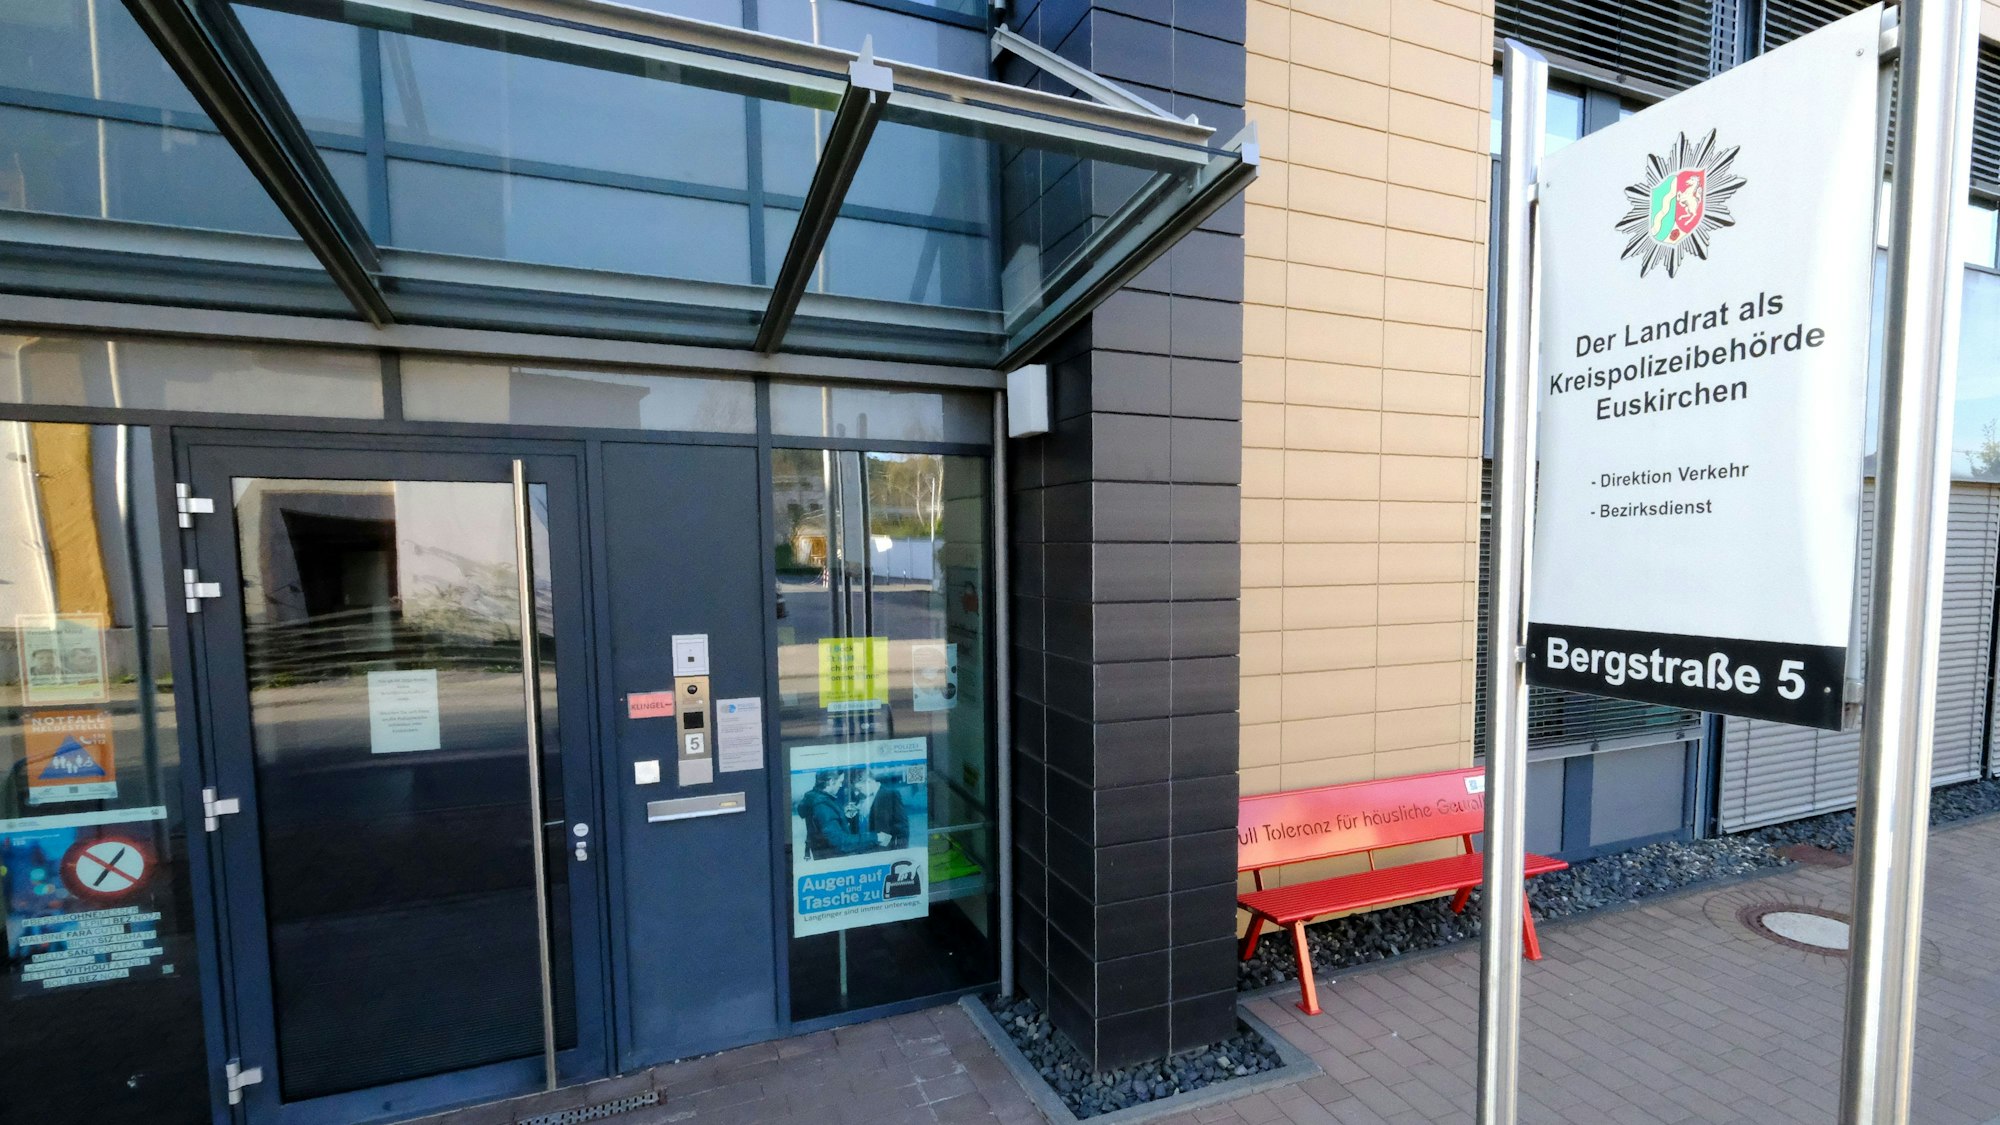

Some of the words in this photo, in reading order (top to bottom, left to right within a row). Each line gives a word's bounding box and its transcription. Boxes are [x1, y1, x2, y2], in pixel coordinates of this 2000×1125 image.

[1576, 333, 1616, 357] Der
[1624, 302, 1729, 347] Landrat
[1739, 292, 1784, 321] als
[1549, 323, 1826, 395] Kreispolizeibehörde
[1596, 380, 1748, 420] Euskirchen
[1600, 470, 1672, 488] Direktion
[1678, 462, 1749, 482] Verkehr
[1599, 499, 1713, 518] Bezirksdienst
[1546, 636, 1761, 695] Bergstraße
[1776, 659, 1806, 700] 5
[631, 702, 665, 711] KLINGEL
[31, 715, 105, 726] NOTFALL
[690, 737, 700, 751] 5
[1238, 827, 1258, 845] ull
[1262, 821, 1332, 841] Toleranz
[1336, 814, 1358, 831] für
[1362, 804, 1433, 826] häusliche
[802, 875, 856, 892] Augen
[859, 869, 883, 884] auf
[846, 885, 862, 893] und
[803, 892, 859, 910] Tasche
[803, 910, 842, 922] Langfinger
[844, 908, 859, 916] sind
[860, 905, 883, 913] immer
[64, 964, 110, 975] WITHOUT
